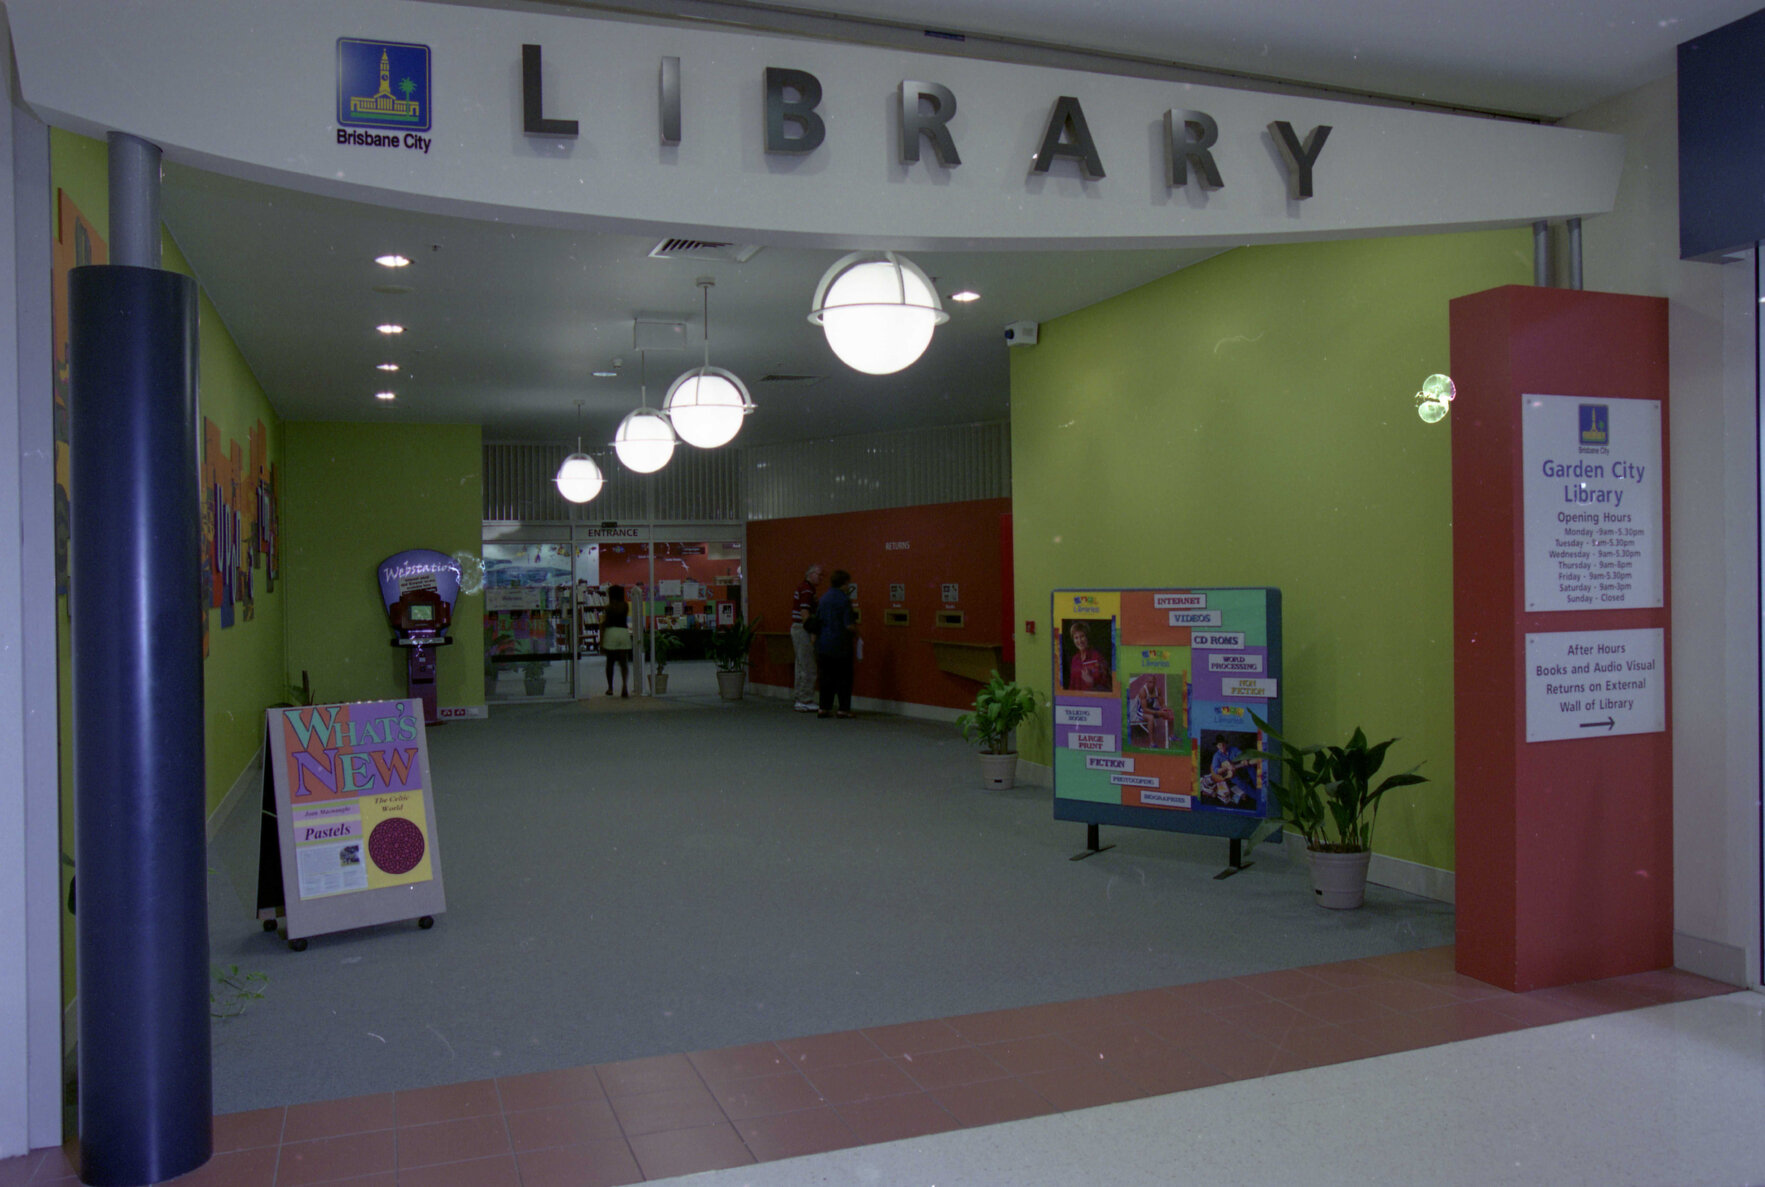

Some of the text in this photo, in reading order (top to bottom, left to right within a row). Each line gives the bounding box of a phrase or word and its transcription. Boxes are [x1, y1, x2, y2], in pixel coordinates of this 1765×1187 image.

[522, 44, 1332, 200] LIBRARY
[337, 128, 432, 154] Brisbane City
[1542, 459, 1645, 484] Garden City
[1564, 485, 1623, 507] Library
[1557, 511, 1632, 525] Opening Hours
[588, 528, 639, 537] ENTRANCE
[1564, 528, 1593, 538] Monday
[885, 541, 910, 550] RETURNS
[1555, 538, 1583, 548] Tuesday
[1549, 550, 1590, 559] Wednesday
[1558, 560, 1591, 570] Thursday
[1558, 572, 1581, 582] Friday
[1559, 583, 1592, 593] Saturday
[1157, 596, 1201, 606] INTERNET
[1567, 594, 1593, 604] Sunday
[1601, 593, 1625, 602] Closed
[1174, 614, 1211, 623] VIDEOS
[1194, 635, 1239, 646] CD ROMS
[1567, 643, 1626, 656] After Hours
[1211, 663, 1257, 671] PROCESSING
[1536, 659, 1656, 677] Books and Audio Visual
[1231, 687, 1265, 695] FICTION
[1546, 678, 1646, 695] Returns on External
[1560, 698, 1634, 713] Wall of Library
[283, 702, 418, 750] WHAT'S
[1079, 742, 1103, 750] PRINT
[1089, 758, 1125, 769] FICTION
[291, 748, 419, 797] NEW
[382, 804, 403, 812] World
[305, 823, 351, 841] Pastels
